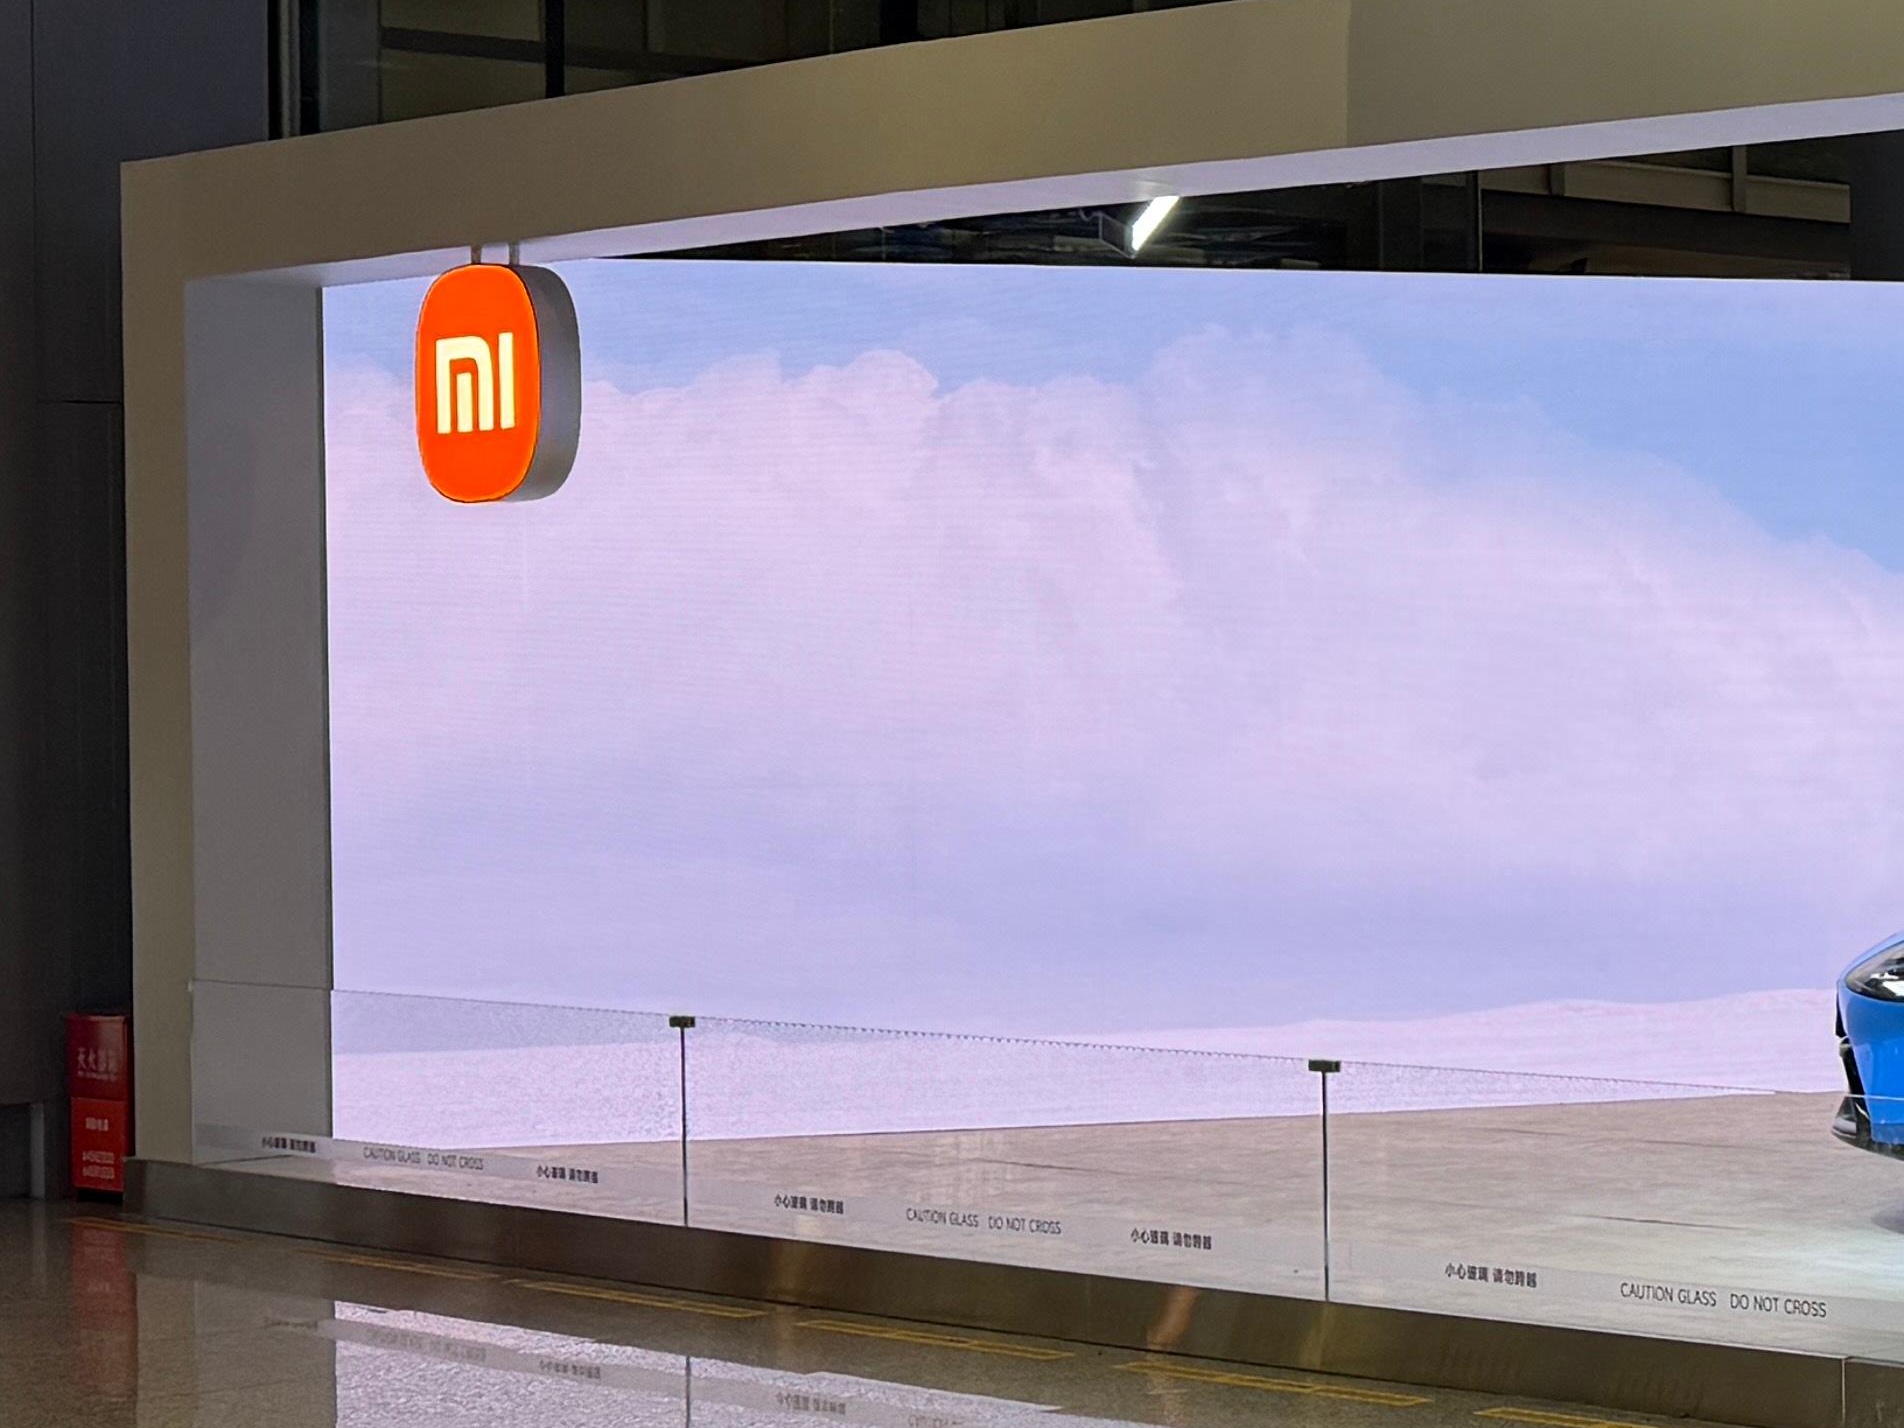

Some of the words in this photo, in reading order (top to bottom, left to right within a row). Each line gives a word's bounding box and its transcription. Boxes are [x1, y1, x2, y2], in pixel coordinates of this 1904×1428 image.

[905, 1207, 947, 1224] CAUTION
[949, 1210, 979, 1228] GLASS
[988, 1215, 1003, 1230] DO
[1006, 1217, 1025, 1233] NOT
[1029, 1219, 1062, 1236] CROSS
[1620, 1281, 1673, 1303] CAUTION
[1677, 1288, 1717, 1309] GLASS
[1730, 1292, 1750, 1311] DO
[1753, 1295, 1780, 1314] NOT
[1783, 1299, 1827, 1318] CROSS
